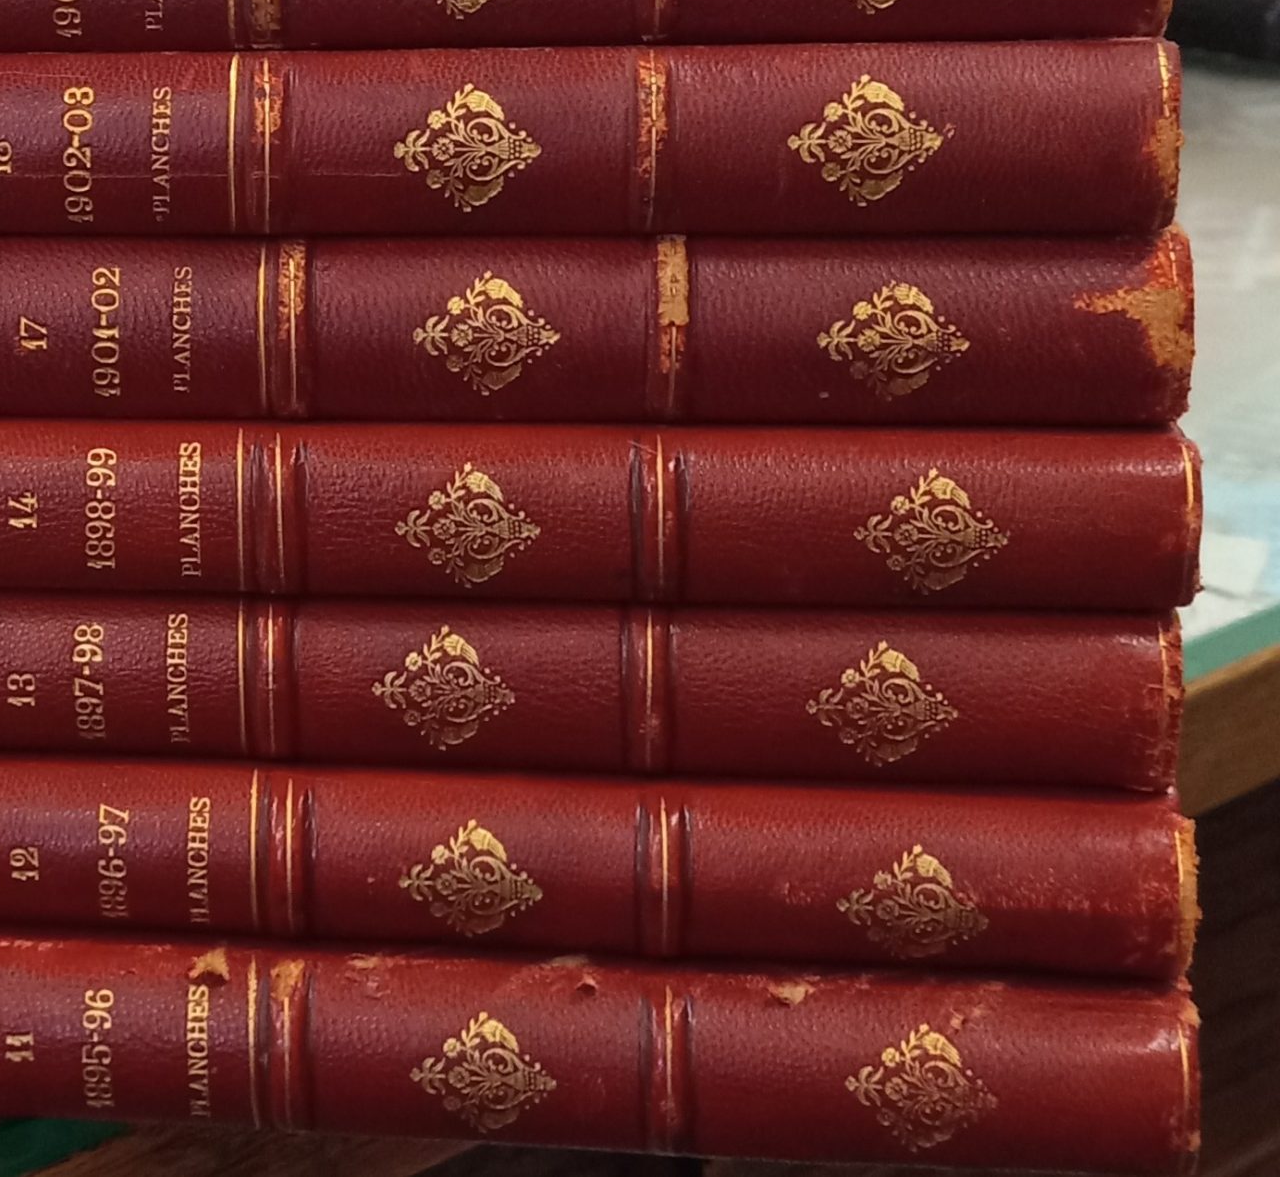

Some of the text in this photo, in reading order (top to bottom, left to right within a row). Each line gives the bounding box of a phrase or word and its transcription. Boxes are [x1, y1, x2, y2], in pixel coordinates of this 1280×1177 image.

[63, 86, 95, 223] 1902-03
[151, 86, 171, 214] PLANCHES
[20, 316, 48, 350] 17
[91, 267, 120, 396] 1901-02
[172, 266, 192, 392] PLANCHES
[8, 492, 39, 529] 14
[85, 448, 117, 569] 1898-99
[179, 442, 201, 577] PLANCHES
[7, 673, 35, 706] 13
[73, 624, 106, 739] 1897-98
[167, 613, 190, 743] PLANCHES
[10, 847, 39, 881] 12
[5, 1032, 35, 1062] 11
[187, 985, 209, 1118] PLANCHES
